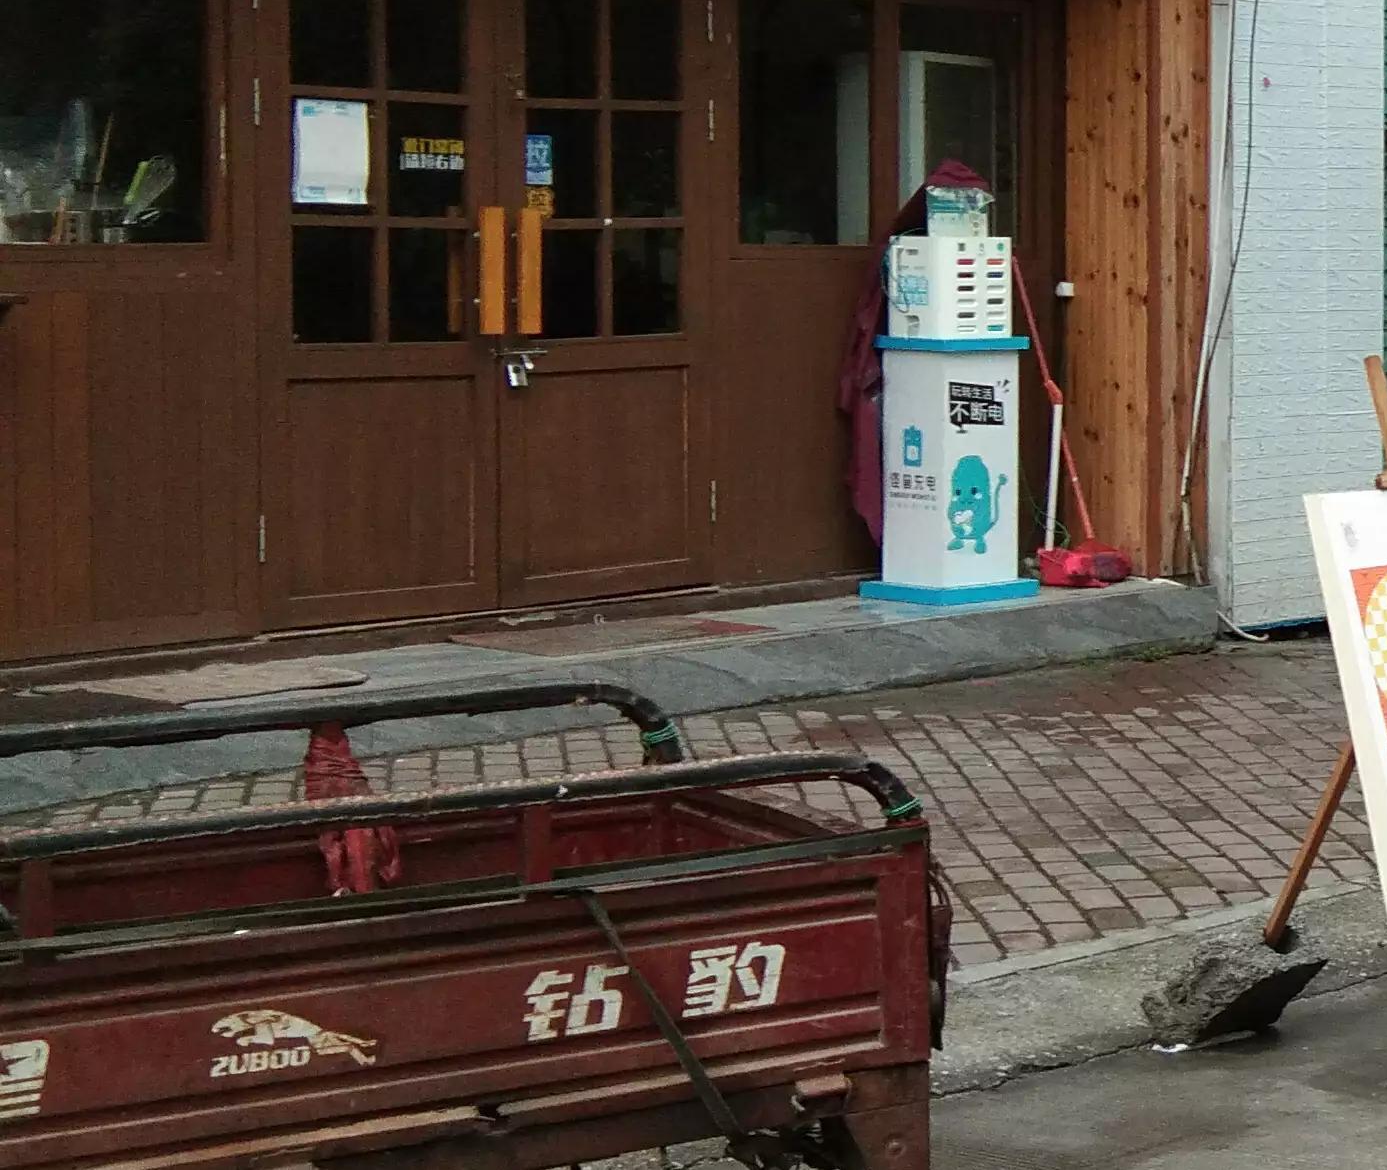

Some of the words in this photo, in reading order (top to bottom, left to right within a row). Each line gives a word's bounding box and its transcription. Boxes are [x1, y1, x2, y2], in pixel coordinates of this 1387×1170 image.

[949, 400, 1005, 423] 不断电
[522, 940, 787, 1043] 钻豹
